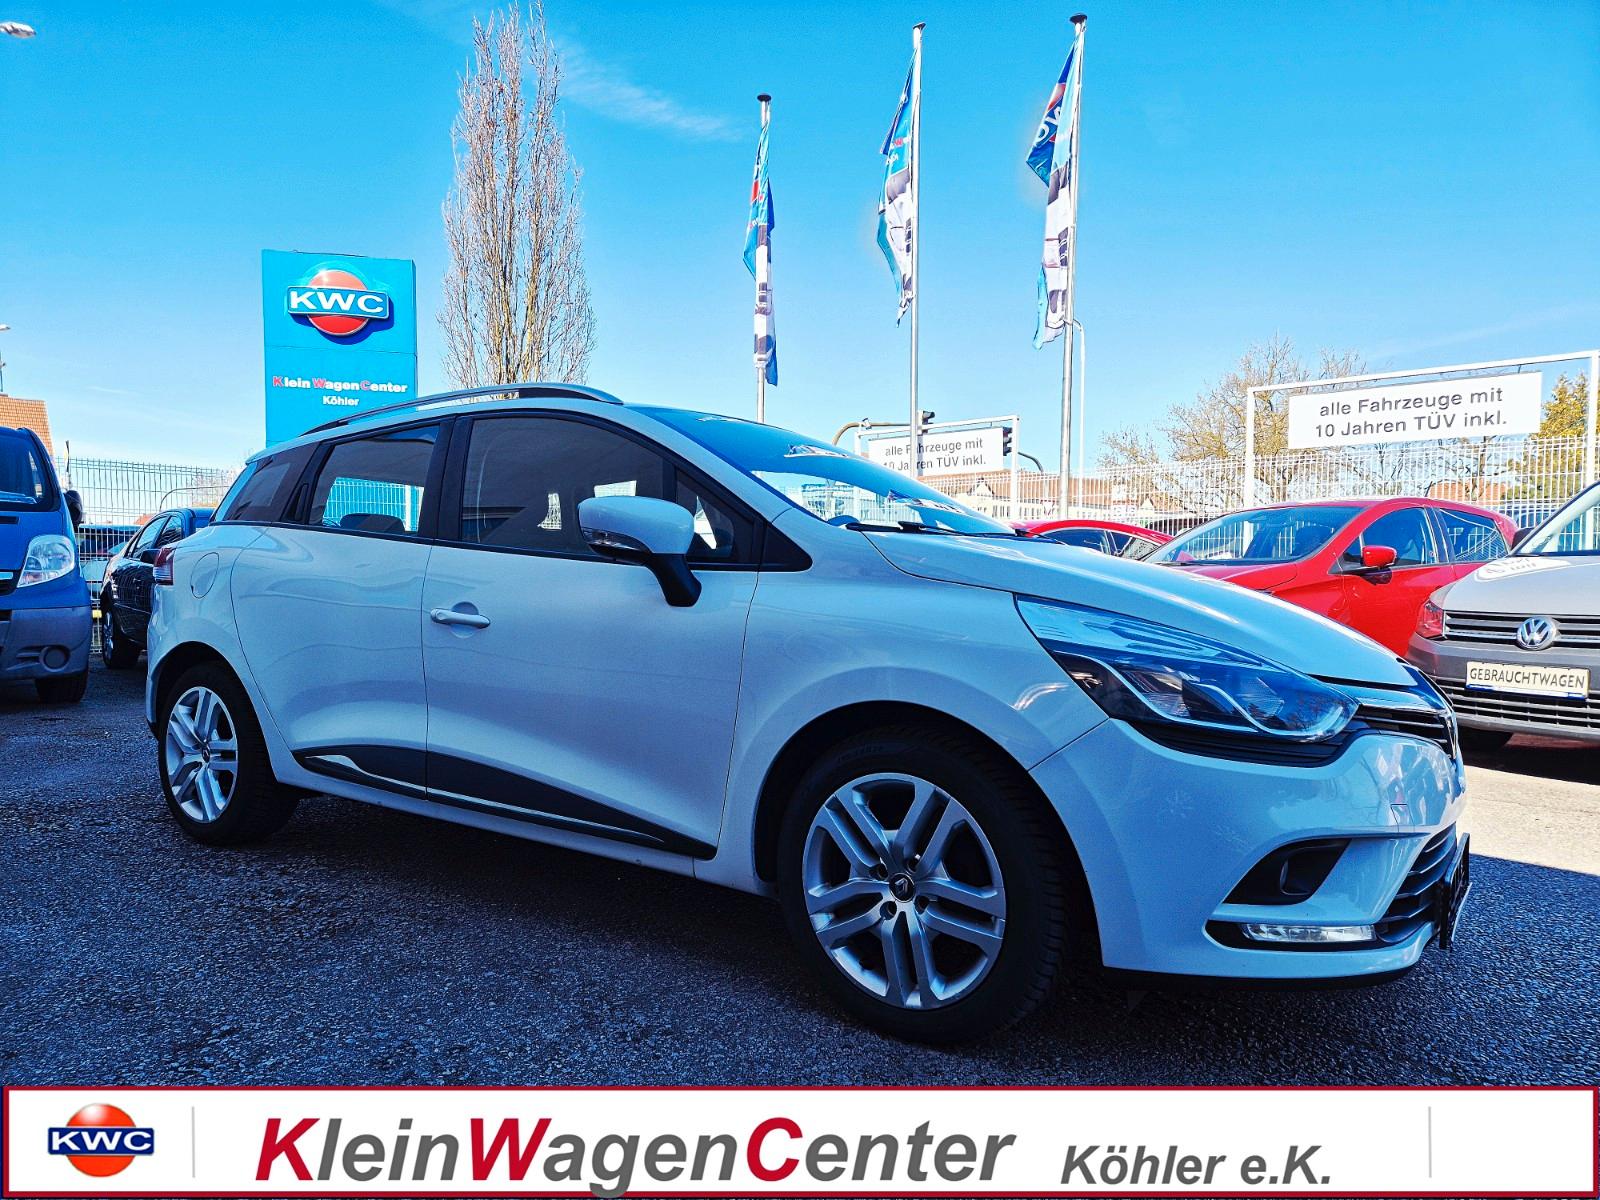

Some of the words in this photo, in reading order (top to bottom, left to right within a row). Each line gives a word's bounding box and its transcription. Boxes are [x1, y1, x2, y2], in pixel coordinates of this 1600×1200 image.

[289, 290, 384, 313] KWC
[322, 395, 360, 406] Köhler
[1320, 401, 1351, 417] alle
[1358, 394, 1463, 414] Fahrzeuge
[1470, 387, 1503, 404] mit
[1315, 423, 1335, 438] 10
[1341, 420, 1406, 436] Jahren
[1414, 411, 1456, 430] TÜV
[1464, 410, 1507, 427] inkl.
[885, 446, 903, 456] alle
[906, 441, 962, 454] Fhrzeuge
[965, 437, 983, 450] mit
[898, 460, 933, 471] Jaren
[936, 453, 959, 468] TÜV
[962, 454, 986, 466] inkl.
[1469, 667, 1585, 689] GEBRAUCHTWAGEN
